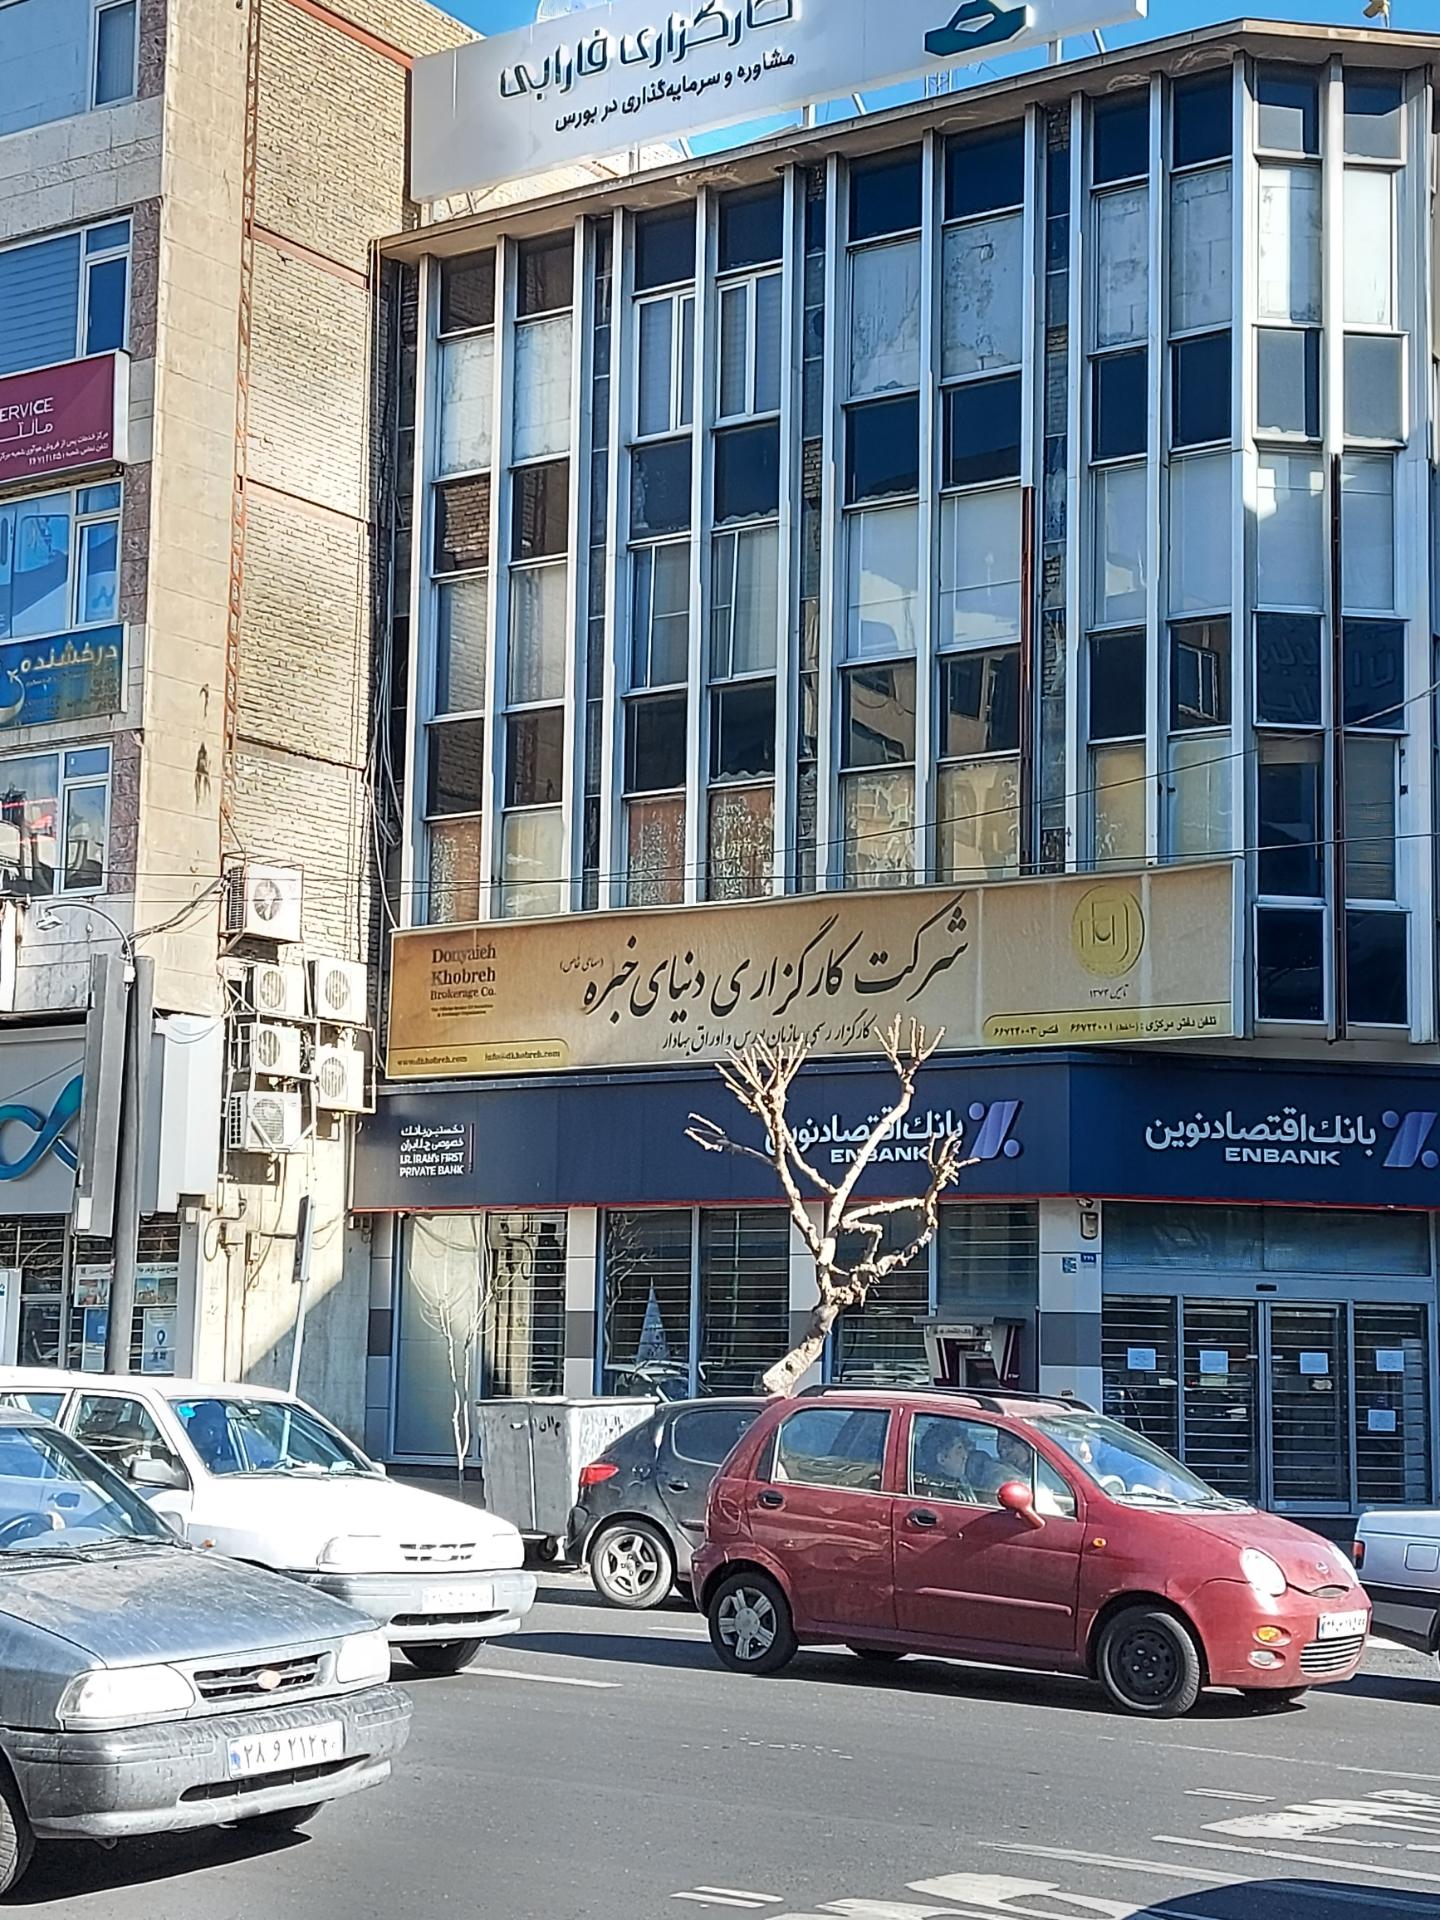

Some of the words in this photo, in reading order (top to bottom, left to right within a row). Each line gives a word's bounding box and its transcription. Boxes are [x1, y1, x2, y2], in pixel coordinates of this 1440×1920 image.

[736, 47, 796, 83] مشاوره
[554, 105, 598, 132] بورس
[602, 98, 618, 120] در
[431, 944, 497, 965] Donyaieh
[854, 891, 969, 1002] شرکت
[710, 913, 863, 1017] کارگزاری
[431, 967, 496, 986] Khobreh
[583, 935, 640, 1024] خبره
[630, 950, 705, 1024] دنیای
[430, 988, 479, 1001] Brokerage
[440, 1151, 465, 1164] FIRST
[1225, 1147, 1341, 1166] ENBANK
[400, 1166, 437, 1178] PRIVATE
[437, 1165, 465, 1176] BANK
